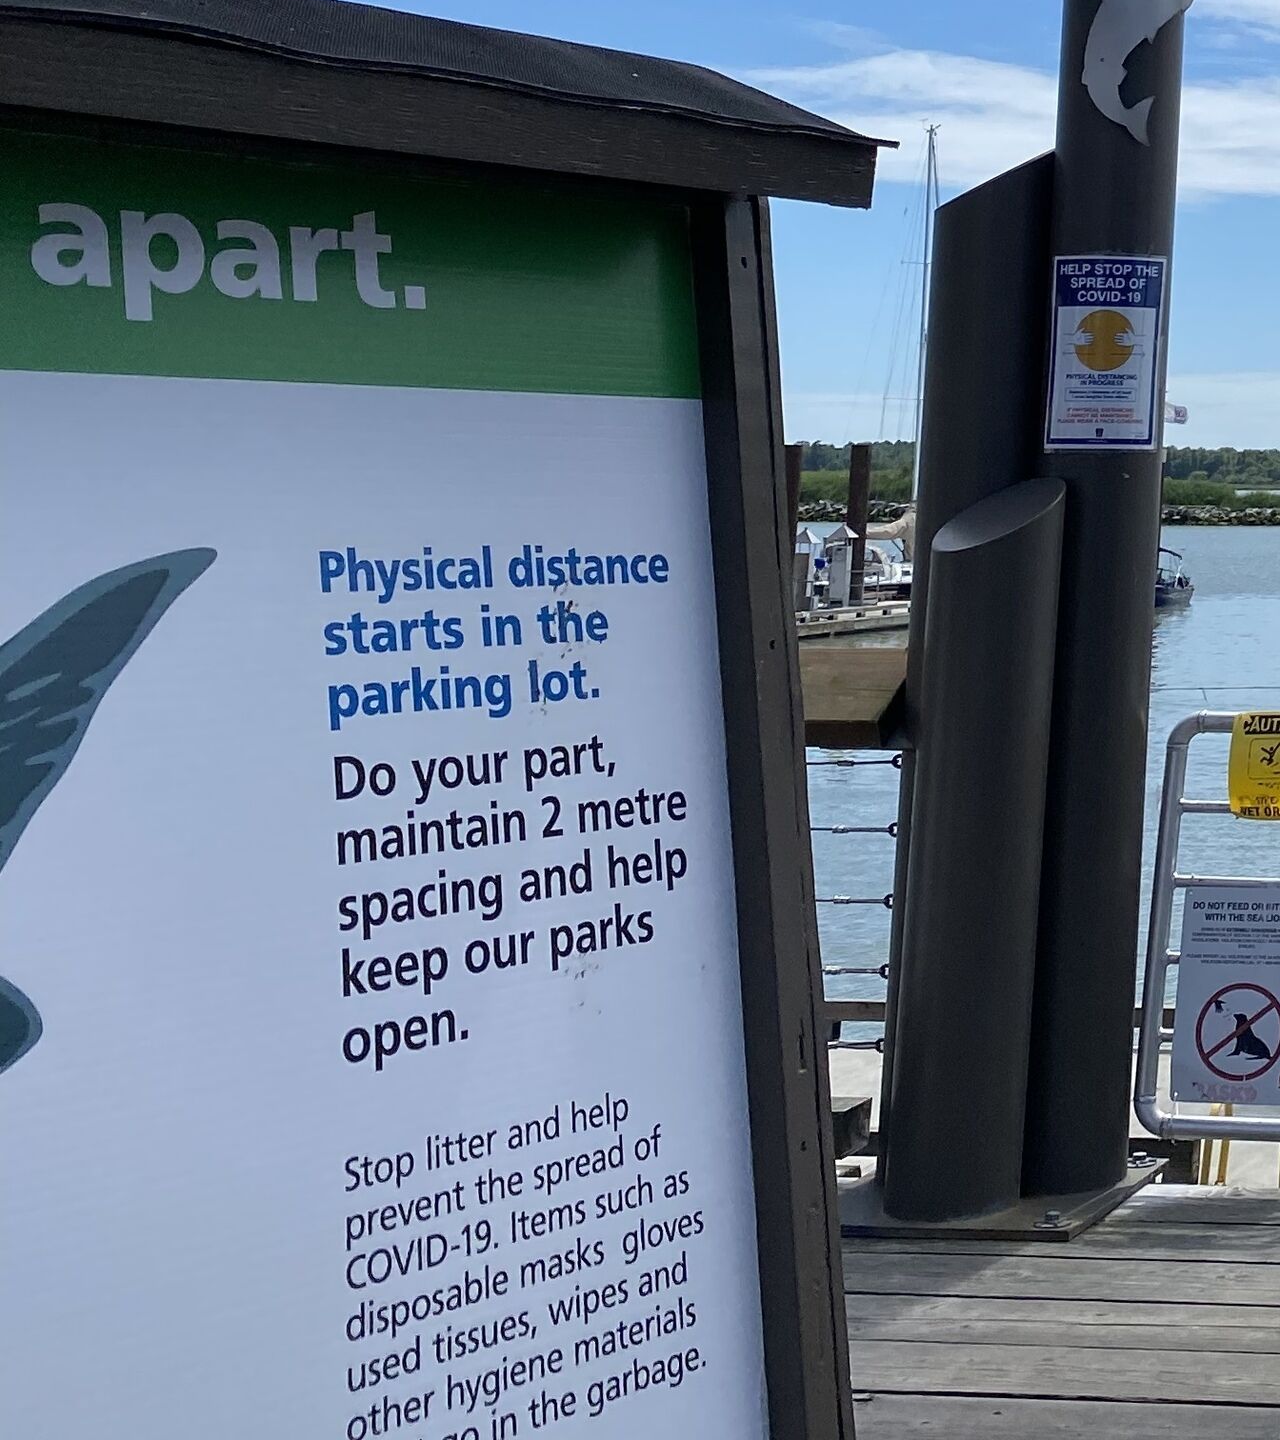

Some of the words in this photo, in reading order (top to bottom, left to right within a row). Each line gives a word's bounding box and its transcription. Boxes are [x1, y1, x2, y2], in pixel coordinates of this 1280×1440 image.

[29, 201, 428, 322] apart.
[1060, 263, 1091, 275] HELP
[1094, 263, 1133, 276] STOP
[1136, 264, 1159, 278] THE
[1070, 277, 1126, 290] SPREAD
[1128, 277, 1148, 290] OF
[1077, 291, 1141, 303] COVID-19
[318, 544, 494, 604] Physical
[508, 544, 670, 589] distance
[323, 609, 465, 656] starts
[481, 604, 522, 647] in
[536, 600, 609, 644] the
[327, 665, 512, 731] parking
[528, 659, 600, 704] lot.
[333, 755, 397, 801] Do
[411, 750, 509, 805] your
[523, 734, 616, 792] part,
[336, 800, 527, 866] maintain
[540, 795, 565, 839] 2
[577, 787, 688, 835] metre
[338, 868, 503, 941] spacing
[519, 847, 592, 903] and
[606, 838, 688, 891] help
[1192, 901, 1206, 911] DO
[1207, 901, 1226, 911] NOT
[1227, 901, 1250, 911] FEED
[1204, 912, 1227, 922] WITH
[1228, 913, 1245, 922] THE
[1246, 913, 1265, 923] SEA
[341, 945, 449, 997] keep
[464, 930, 535, 974] our
[549, 902, 655, 971] parks
[342, 1008, 469, 1072] open.
[344, 1149, 416, 1193] Stop
[425, 1129, 498, 1171] litter
[507, 1104, 561, 1150] and
[570, 1092, 630, 1133] help
[345, 1180, 466, 1251] prevent
[474, 1167, 524, 1205] the
[533, 1134, 625, 1196] spread
[633, 1123, 663, 1162] of
[345, 1219, 500, 1290] COVID-19.
[510, 1199, 587, 1244] Items
[594, 1173, 654, 1215] such
[663, 1169, 691, 1198] as
[345, 1264, 509, 1342] disposable
[519, 1236, 605, 1288] masks
[621, 1208, 705, 1265] gloves
[347, 1335, 422, 1393] used
[431, 1310, 538, 1365] tissues,
[547, 1278, 629, 1339] wipes
[638, 1250, 688, 1297] and
[346, 1389, 436, 1440] other
[446, 1348, 564, 1414] hygiene
[574, 1296, 697, 1366] materials
[491, 1409, 518, 1440] in
[527, 1389, 577, 1429] the
[586, 1345, 708, 1417] garbage.
